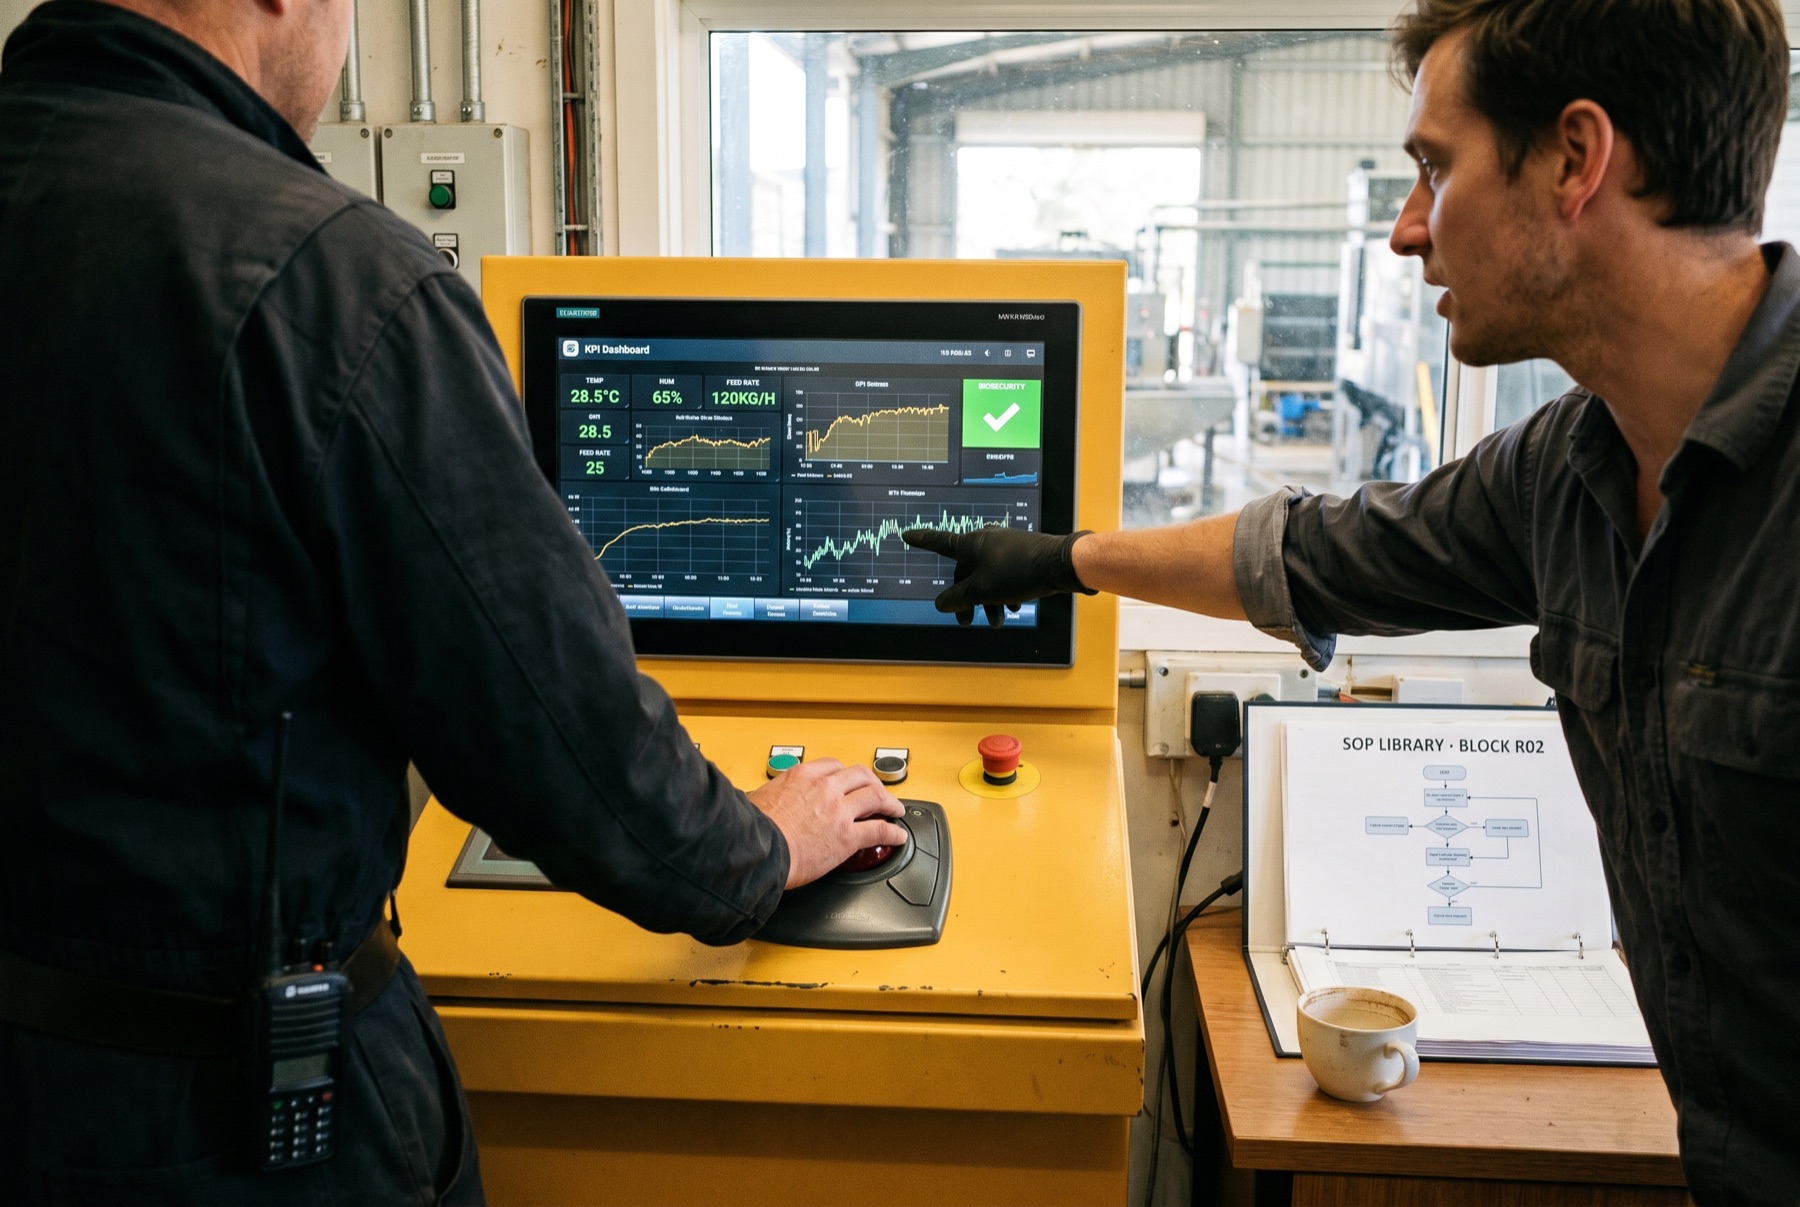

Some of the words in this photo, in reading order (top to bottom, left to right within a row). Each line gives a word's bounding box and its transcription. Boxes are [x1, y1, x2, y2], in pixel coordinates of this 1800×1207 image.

[584, 344, 600, 354] KPI
[602, 344, 650, 355] Dashboard
[978, 382, 1026, 391] BIOSECURITY
[570, 389, 620, 403] 28.5°C
[652, 390, 683, 405] 65%
[712, 391, 776, 406] 120KG/H
[579, 425, 612, 439] 28.5
[586, 461, 605, 475] 25
[1342, 737, 1374, 751] SOP
[1378, 738, 1445, 752] LIBRARY
[1459, 739, 1511, 753] BLOCK
[1515, 740, 1545, 754] R02
